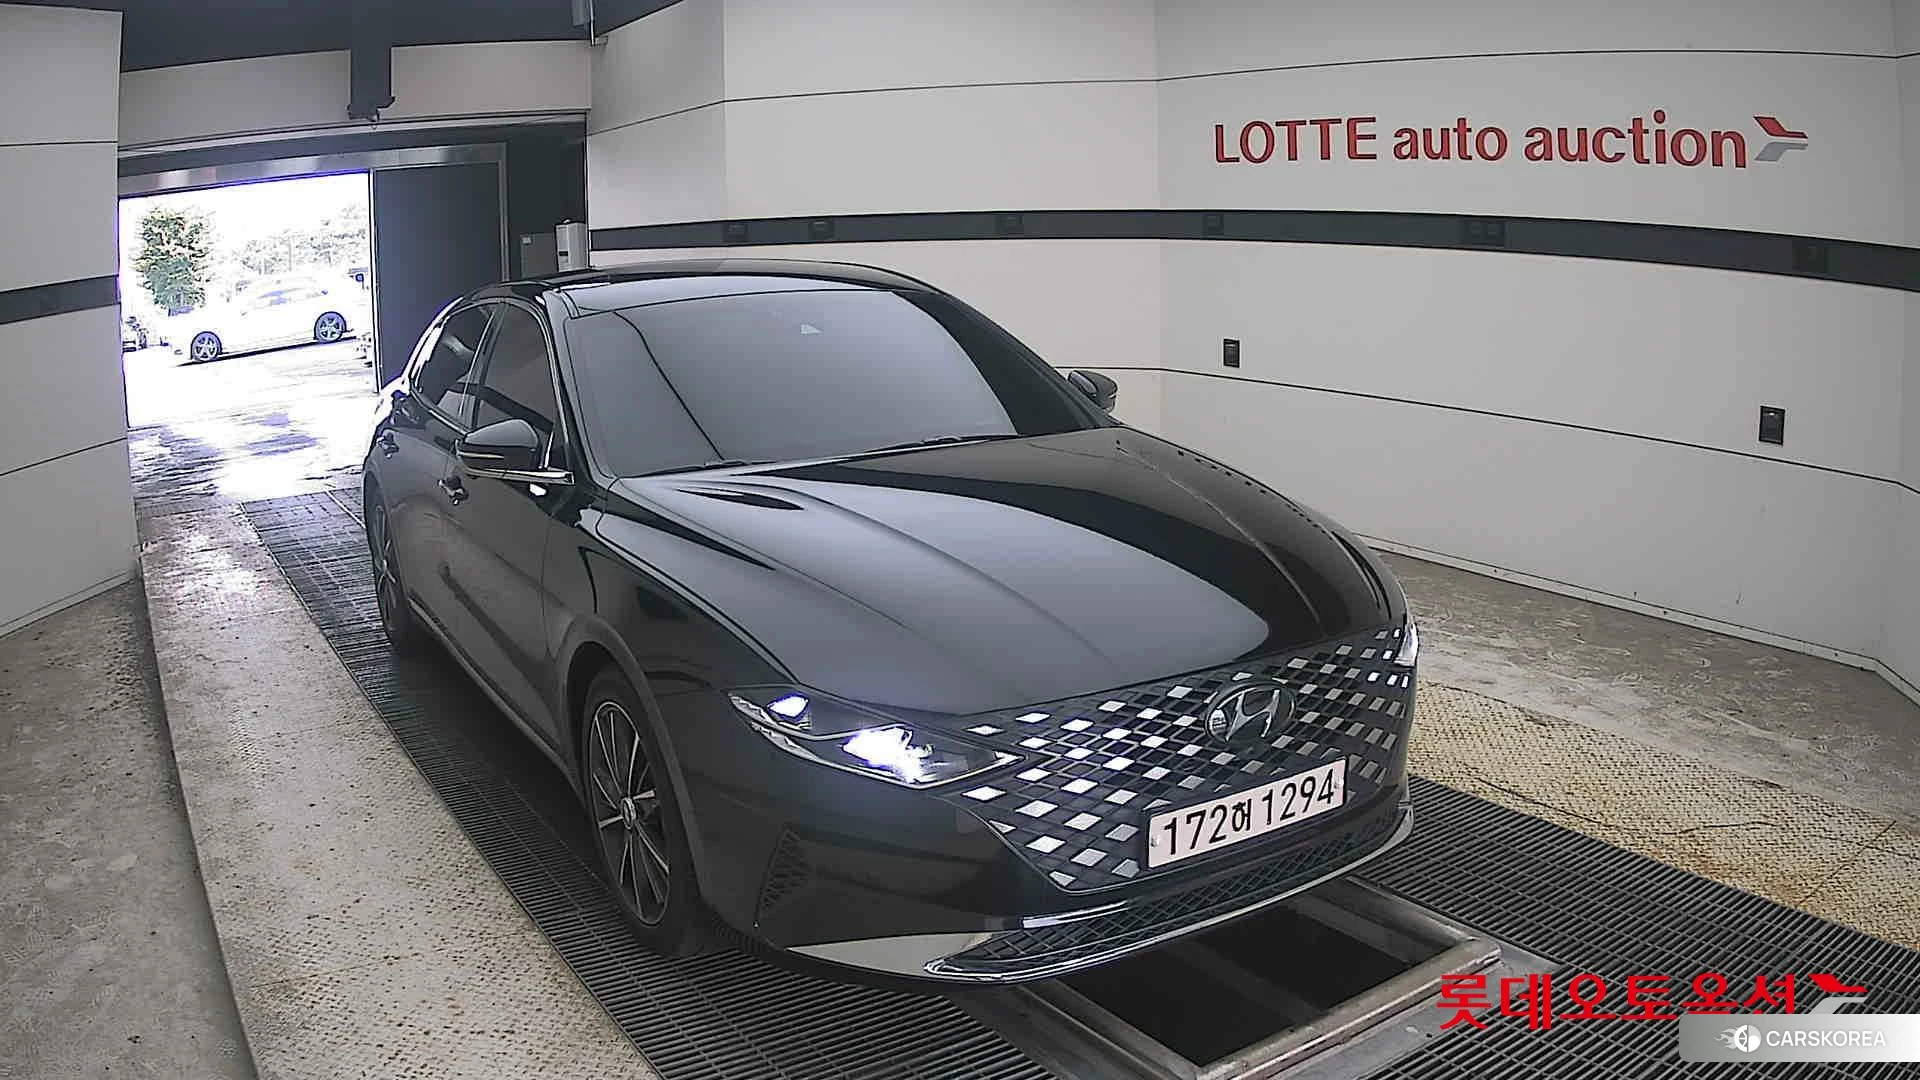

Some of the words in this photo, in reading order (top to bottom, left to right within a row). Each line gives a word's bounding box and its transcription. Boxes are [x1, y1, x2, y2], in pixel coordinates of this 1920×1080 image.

[1214, 116, 1378, 164] LOTTE
[1392, 117, 1509, 162] auto
[1523, 109, 1747, 169] auction
[1163, 798, 1252, 856] 172허
[1262, 768, 1335, 826] 1294
